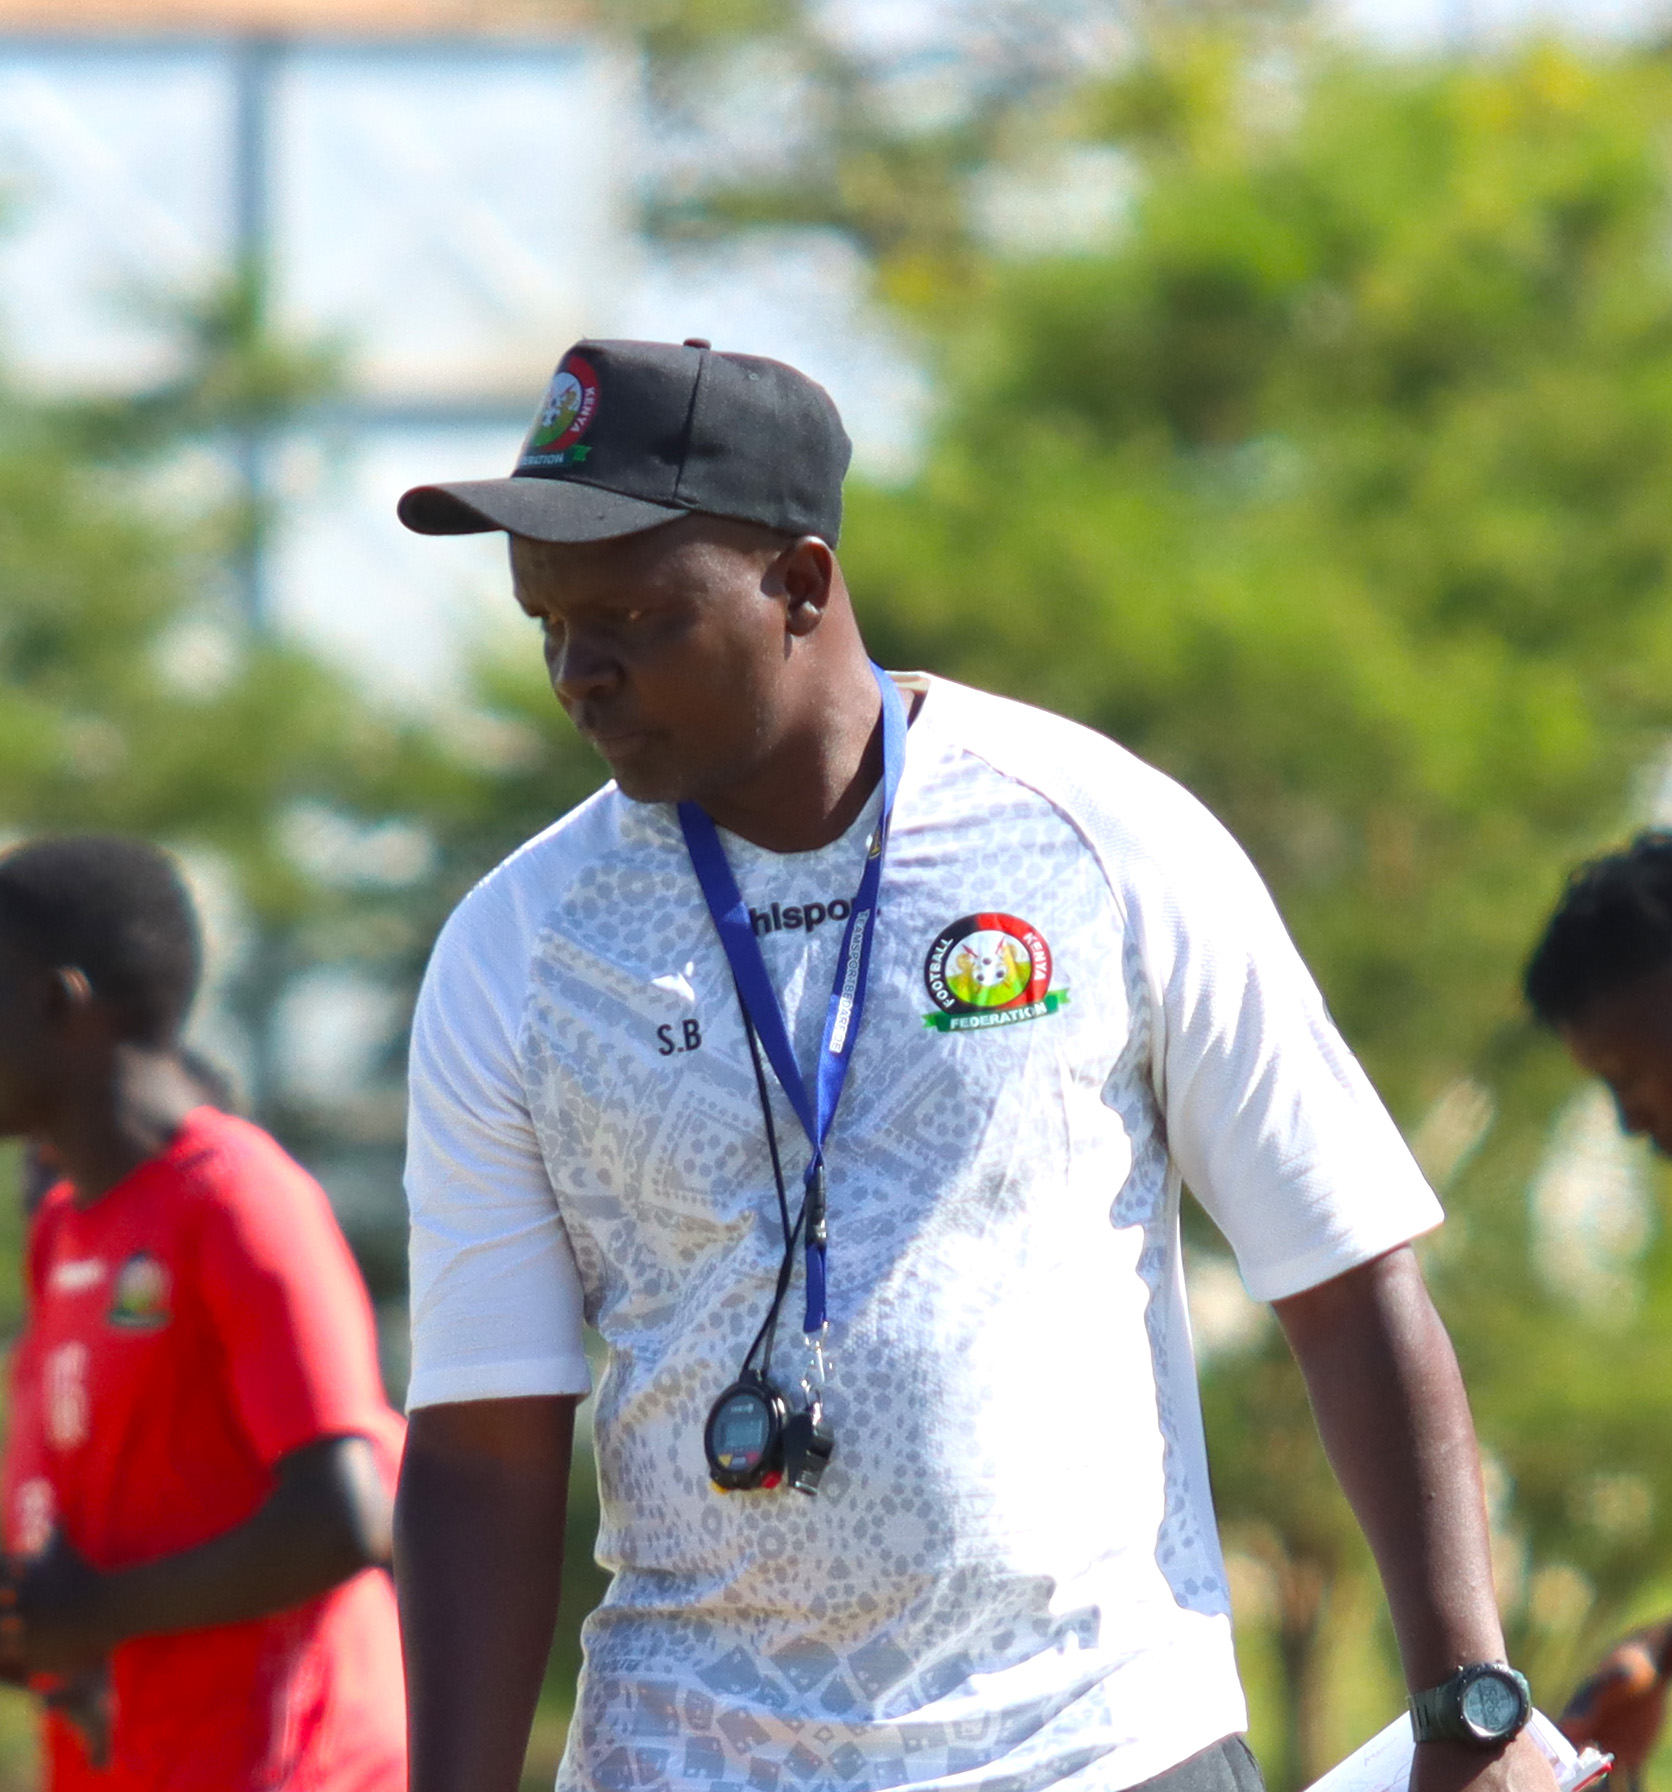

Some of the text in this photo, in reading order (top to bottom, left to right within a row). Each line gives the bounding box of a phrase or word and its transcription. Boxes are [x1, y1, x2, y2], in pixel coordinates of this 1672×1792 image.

[570, 386, 596, 433] KENYA
[749, 897, 881, 937] hlspo
[930, 938, 955, 1009] FOOTBALL
[1023, 932, 1048, 981] KENYA
[949, 1001, 1048, 1030] FEDERATION
[656, 1018, 702, 1057] S.B
